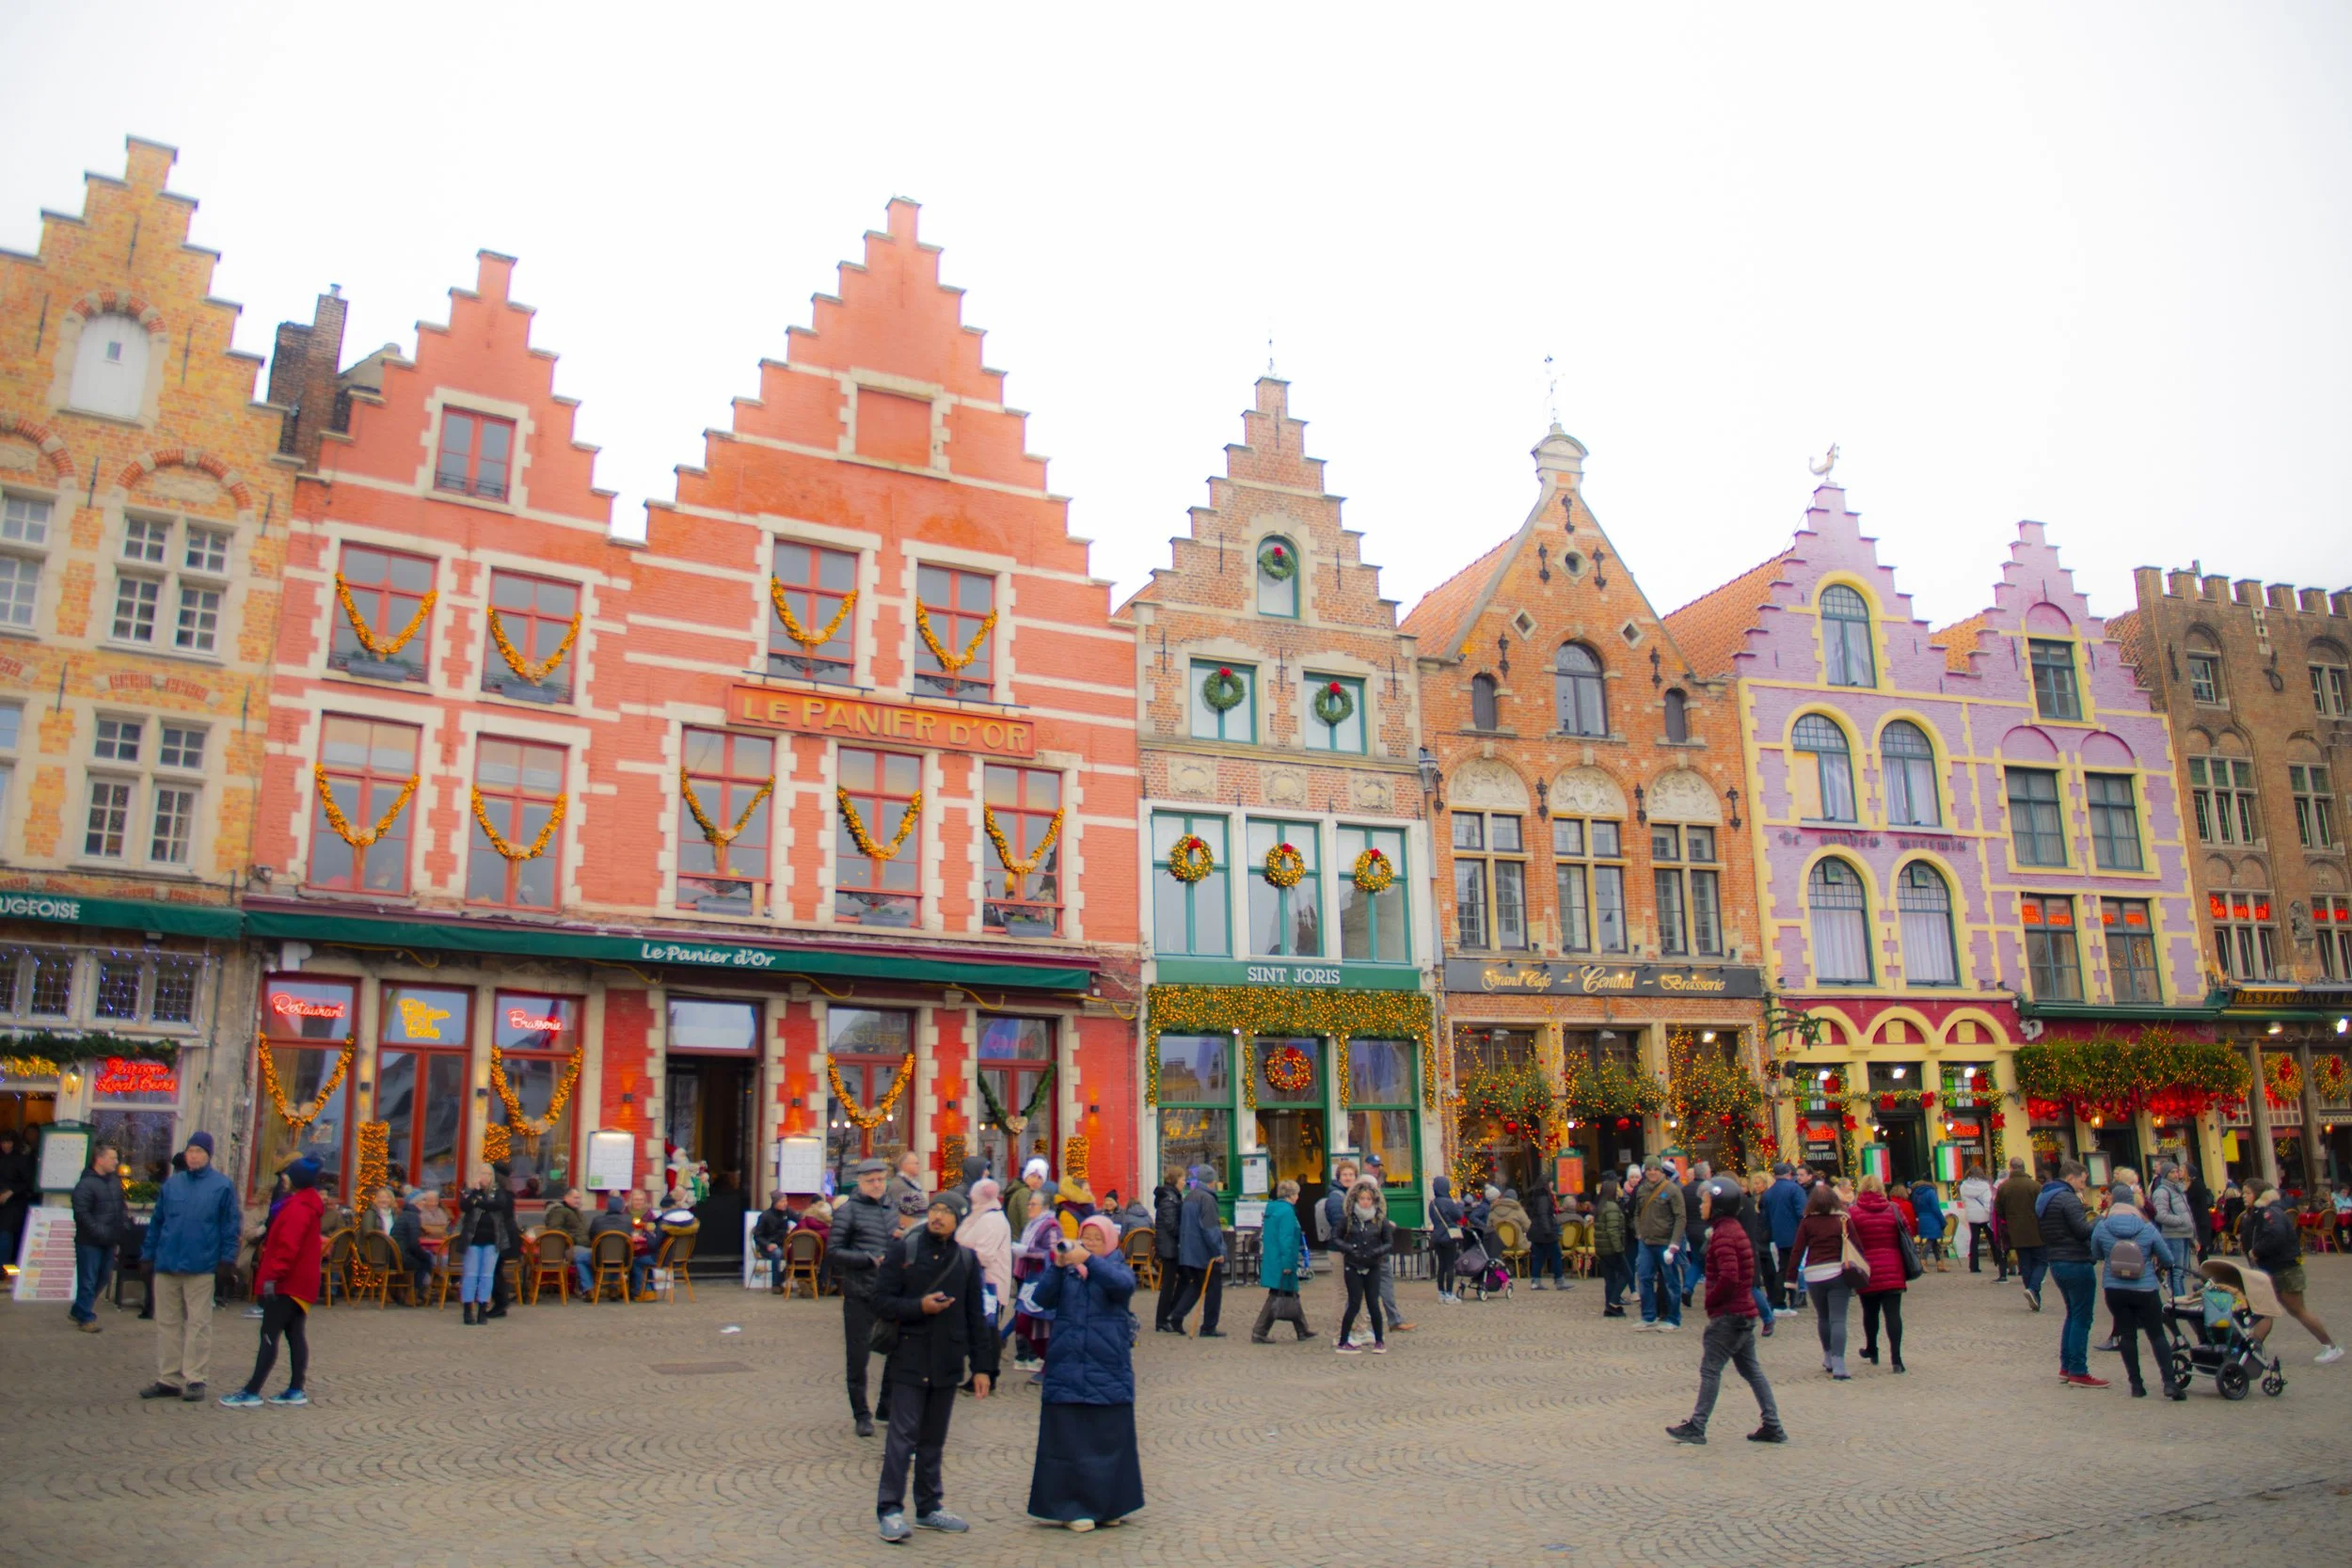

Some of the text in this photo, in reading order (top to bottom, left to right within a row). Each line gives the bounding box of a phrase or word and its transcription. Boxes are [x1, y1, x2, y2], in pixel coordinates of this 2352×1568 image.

[743, 696, 1029, 752] LE PANIER D'OR
[642, 942, 775, 967] Le Panier d'Or
[1248, 966, 1341, 985] SINT JORIS
[1482, 970, 1524, 991] Grand
[1581, 965, 1636, 993] Central
[1659, 974, 1726, 991] Brasserie
[272, 992, 345, 1019] Restaurant
[506, 1007, 563, 1031] Brasserie
